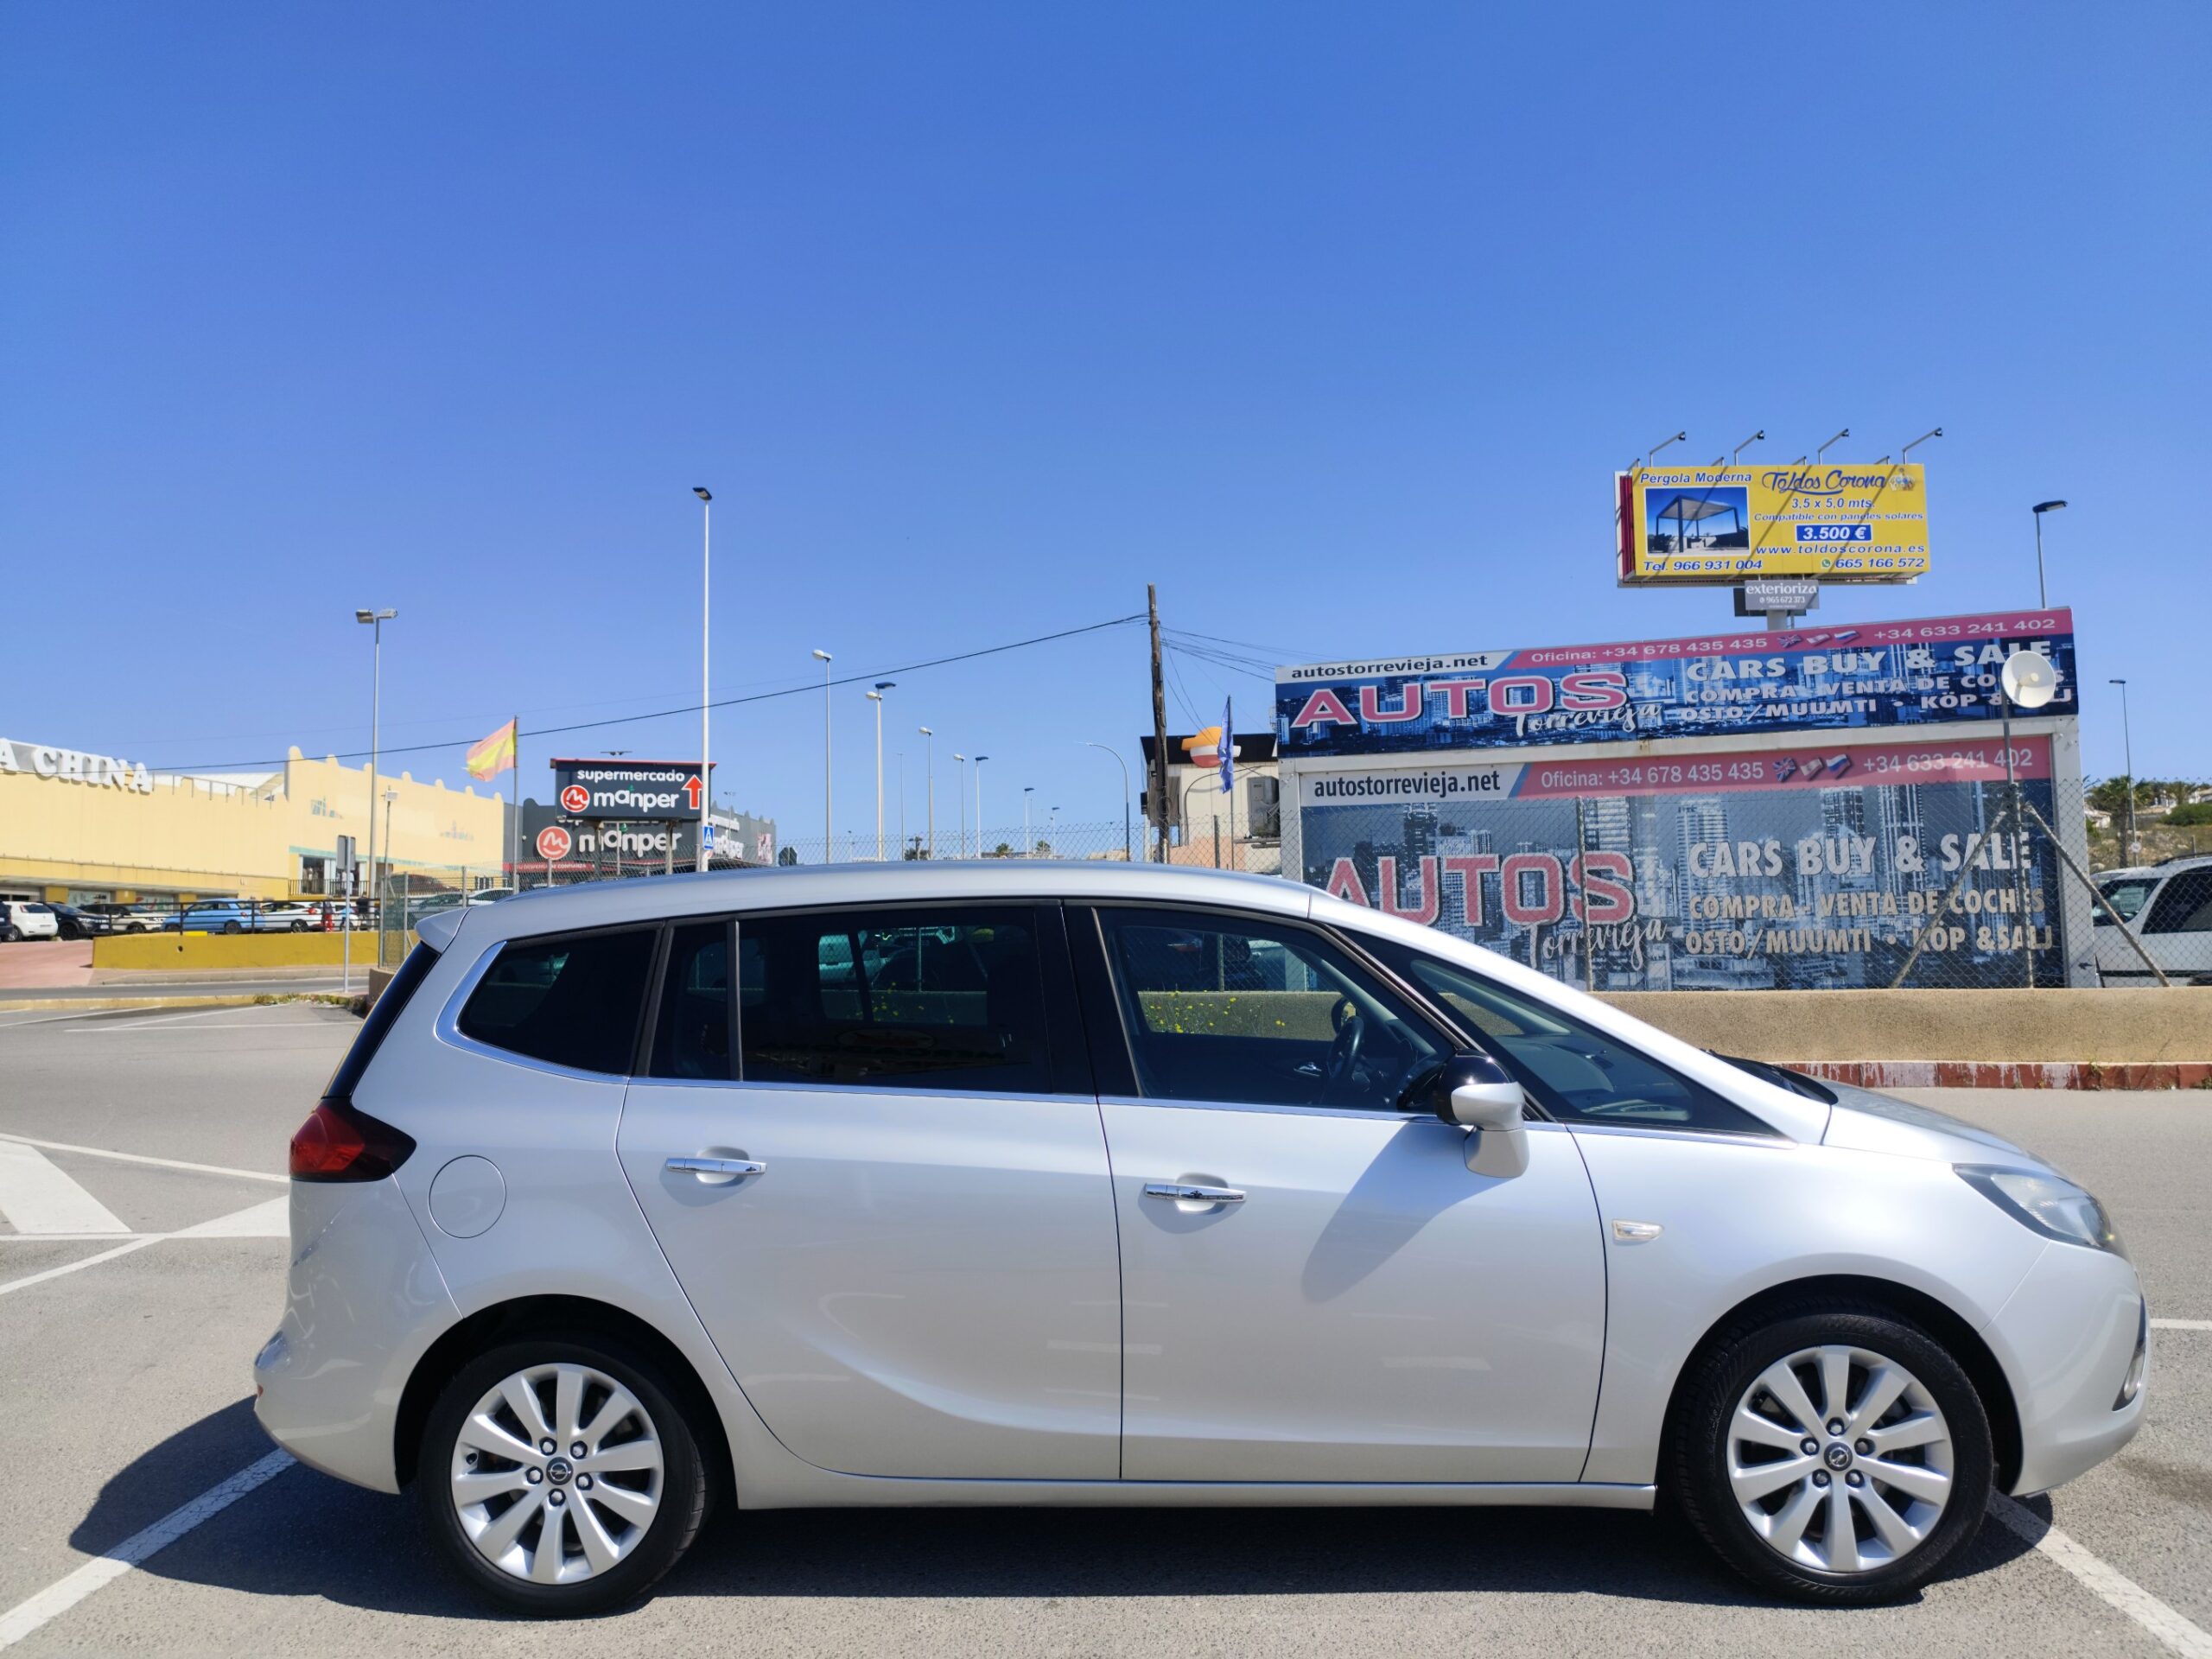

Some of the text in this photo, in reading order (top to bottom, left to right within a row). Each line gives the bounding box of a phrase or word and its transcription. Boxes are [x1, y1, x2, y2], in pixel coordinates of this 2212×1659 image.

[1695, 473, 1751, 482] Moderna
[1762, 470, 1886, 494] Toldos Corona
[1792, 499, 1810, 509] 3,5
[1826, 499, 1844, 509] 5,0
[1754, 513, 1814, 522] Compatible
[1840, 513, 1881, 522] paneles
[1802, 527, 1866, 540] 3.500 €
[1756, 544, 1924, 555] www.toldoscorona.es
[1643, 560, 1762, 570] Tel. 966 931 004
[1835, 557, 1924, 569] 665 166 572
[1746, 582, 1817, 594] exterioriza
[1531, 619, 2056, 663] Oficina: +34 678 435 435 +34 633 241 402
[1291, 655, 1488, 679] autostorrevieja.net
[1686, 657, 1786, 682] CARS
[1803, 651, 1886, 676] BUY
[1906, 649, 1936, 669] &
[1290, 671, 1630, 728] AUTOS
[1685, 684, 1797, 703] COMPRA
[1823, 677, 1906, 695] VENTA
[1917, 676, 1949, 690] DE
[1921, 692, 1977, 709] KÖP
[1506, 703, 1662, 737] Torrevieja
[33, 746, 153, 792] CHINA
[577, 769, 685, 783] supermercado
[1541, 769, 1602, 788] Oficina:
[1608, 767, 1642, 785] +34
[1647, 766, 1682, 784] 678
[1687, 764, 1723, 782] 435
[1727, 762, 1763, 779] 435
[1864, 754, 1900, 773] +34
[1907, 752, 1944, 772] 633
[1951, 750, 1989, 769] 241
[1314, 769, 1500, 798] autostorrevieja.net
[593, 789, 679, 812] manper
[579, 830, 682, 857] manper
[1688, 832, 2031, 879] CARS BUY & SALE
[1325, 850, 1635, 926] AUTOS
[1690, 894, 1796, 919] COMPRA
[1820, 891, 1898, 917] VENTA
[1908, 890, 1938, 915] DE
[1521, 917, 1668, 969] Torrevieja
